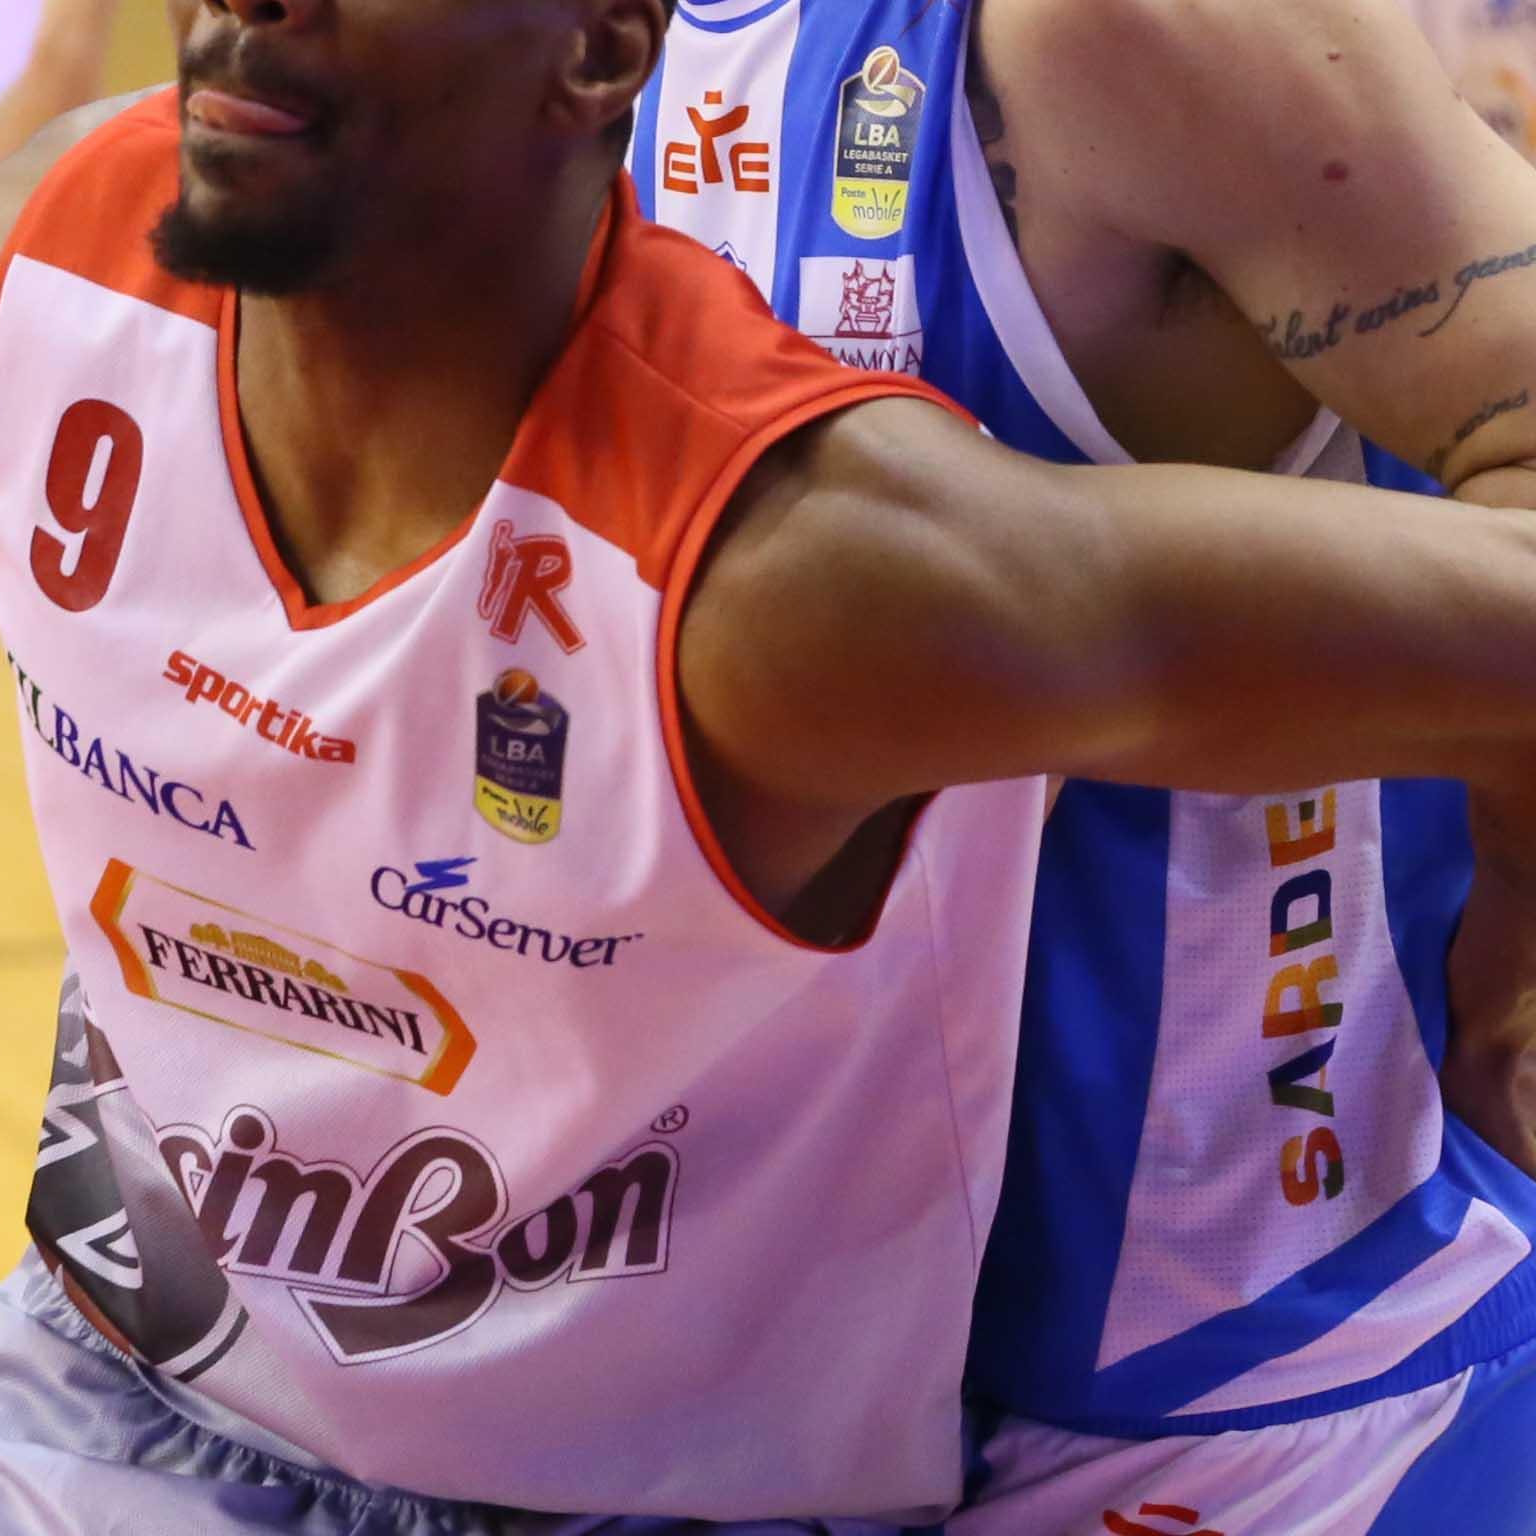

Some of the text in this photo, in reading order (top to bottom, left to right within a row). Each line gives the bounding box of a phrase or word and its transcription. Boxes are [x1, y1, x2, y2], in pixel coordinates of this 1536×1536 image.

[854, 122, 902, 148] LBA
[843, 149, 909, 163] LEGABASKET
[855, 162, 884, 174] SERIE
[852, 187, 903, 222] mobile
[30, 398, 144, 613] 9
[162, 649, 356, 765] sportika
[490, 735, 546, 763] LBA
[369, 865, 638, 968] CarServer
[137, 922, 429, 1056] FERRARINI
